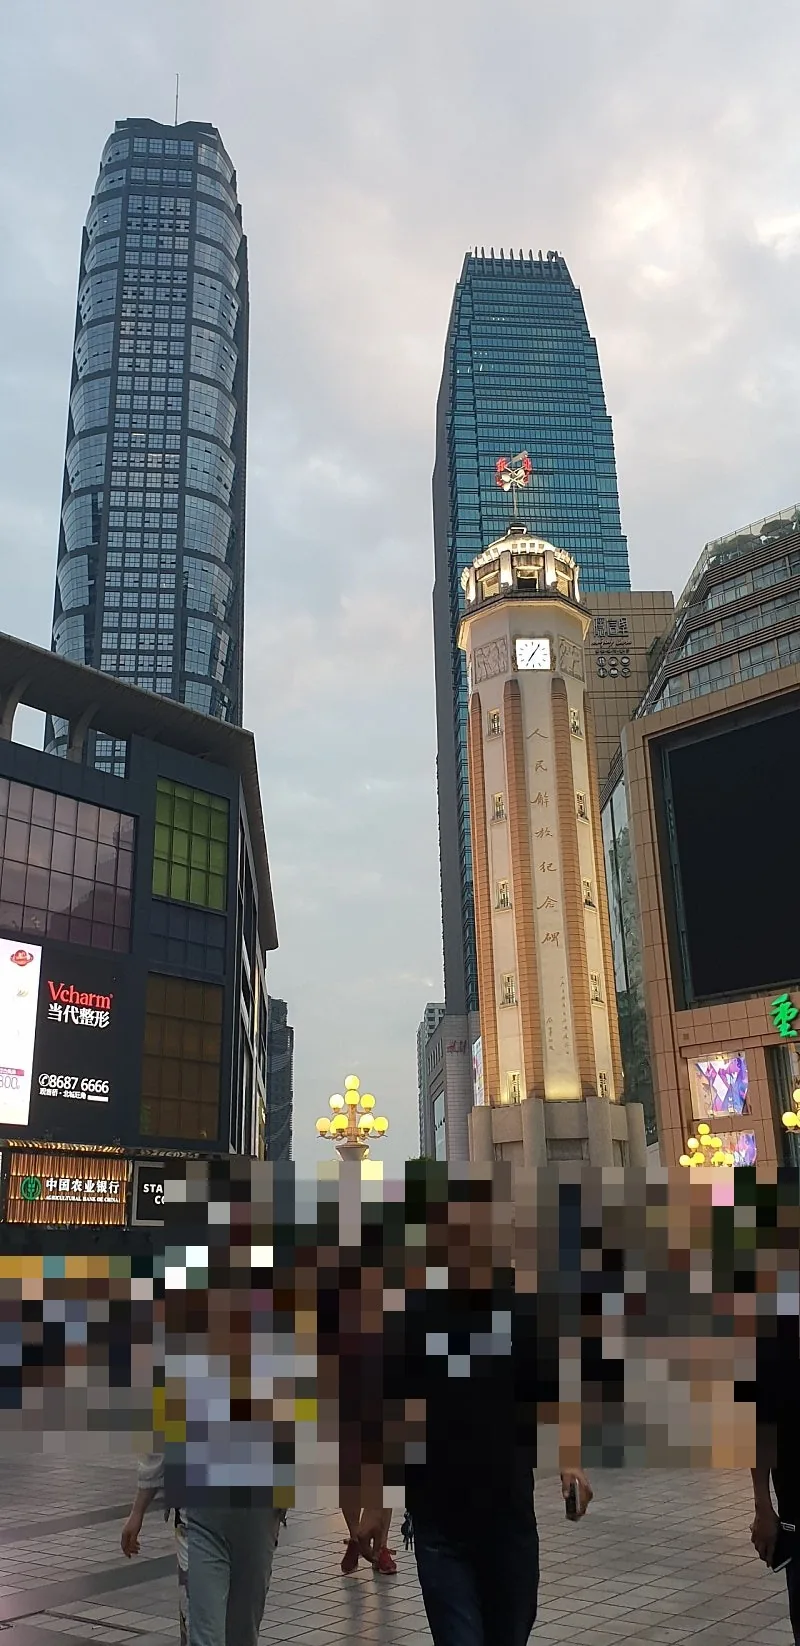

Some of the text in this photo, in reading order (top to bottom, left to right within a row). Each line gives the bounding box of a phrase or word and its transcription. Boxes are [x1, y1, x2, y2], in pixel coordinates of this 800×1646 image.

[47, 980, 111, 1010] Vcharm
[47, 1003, 110, 1028] 当代整形
[49, 1074, 110, 1094] 8687 6666
[46, 1178, 120, 1194] 中国农业银行
